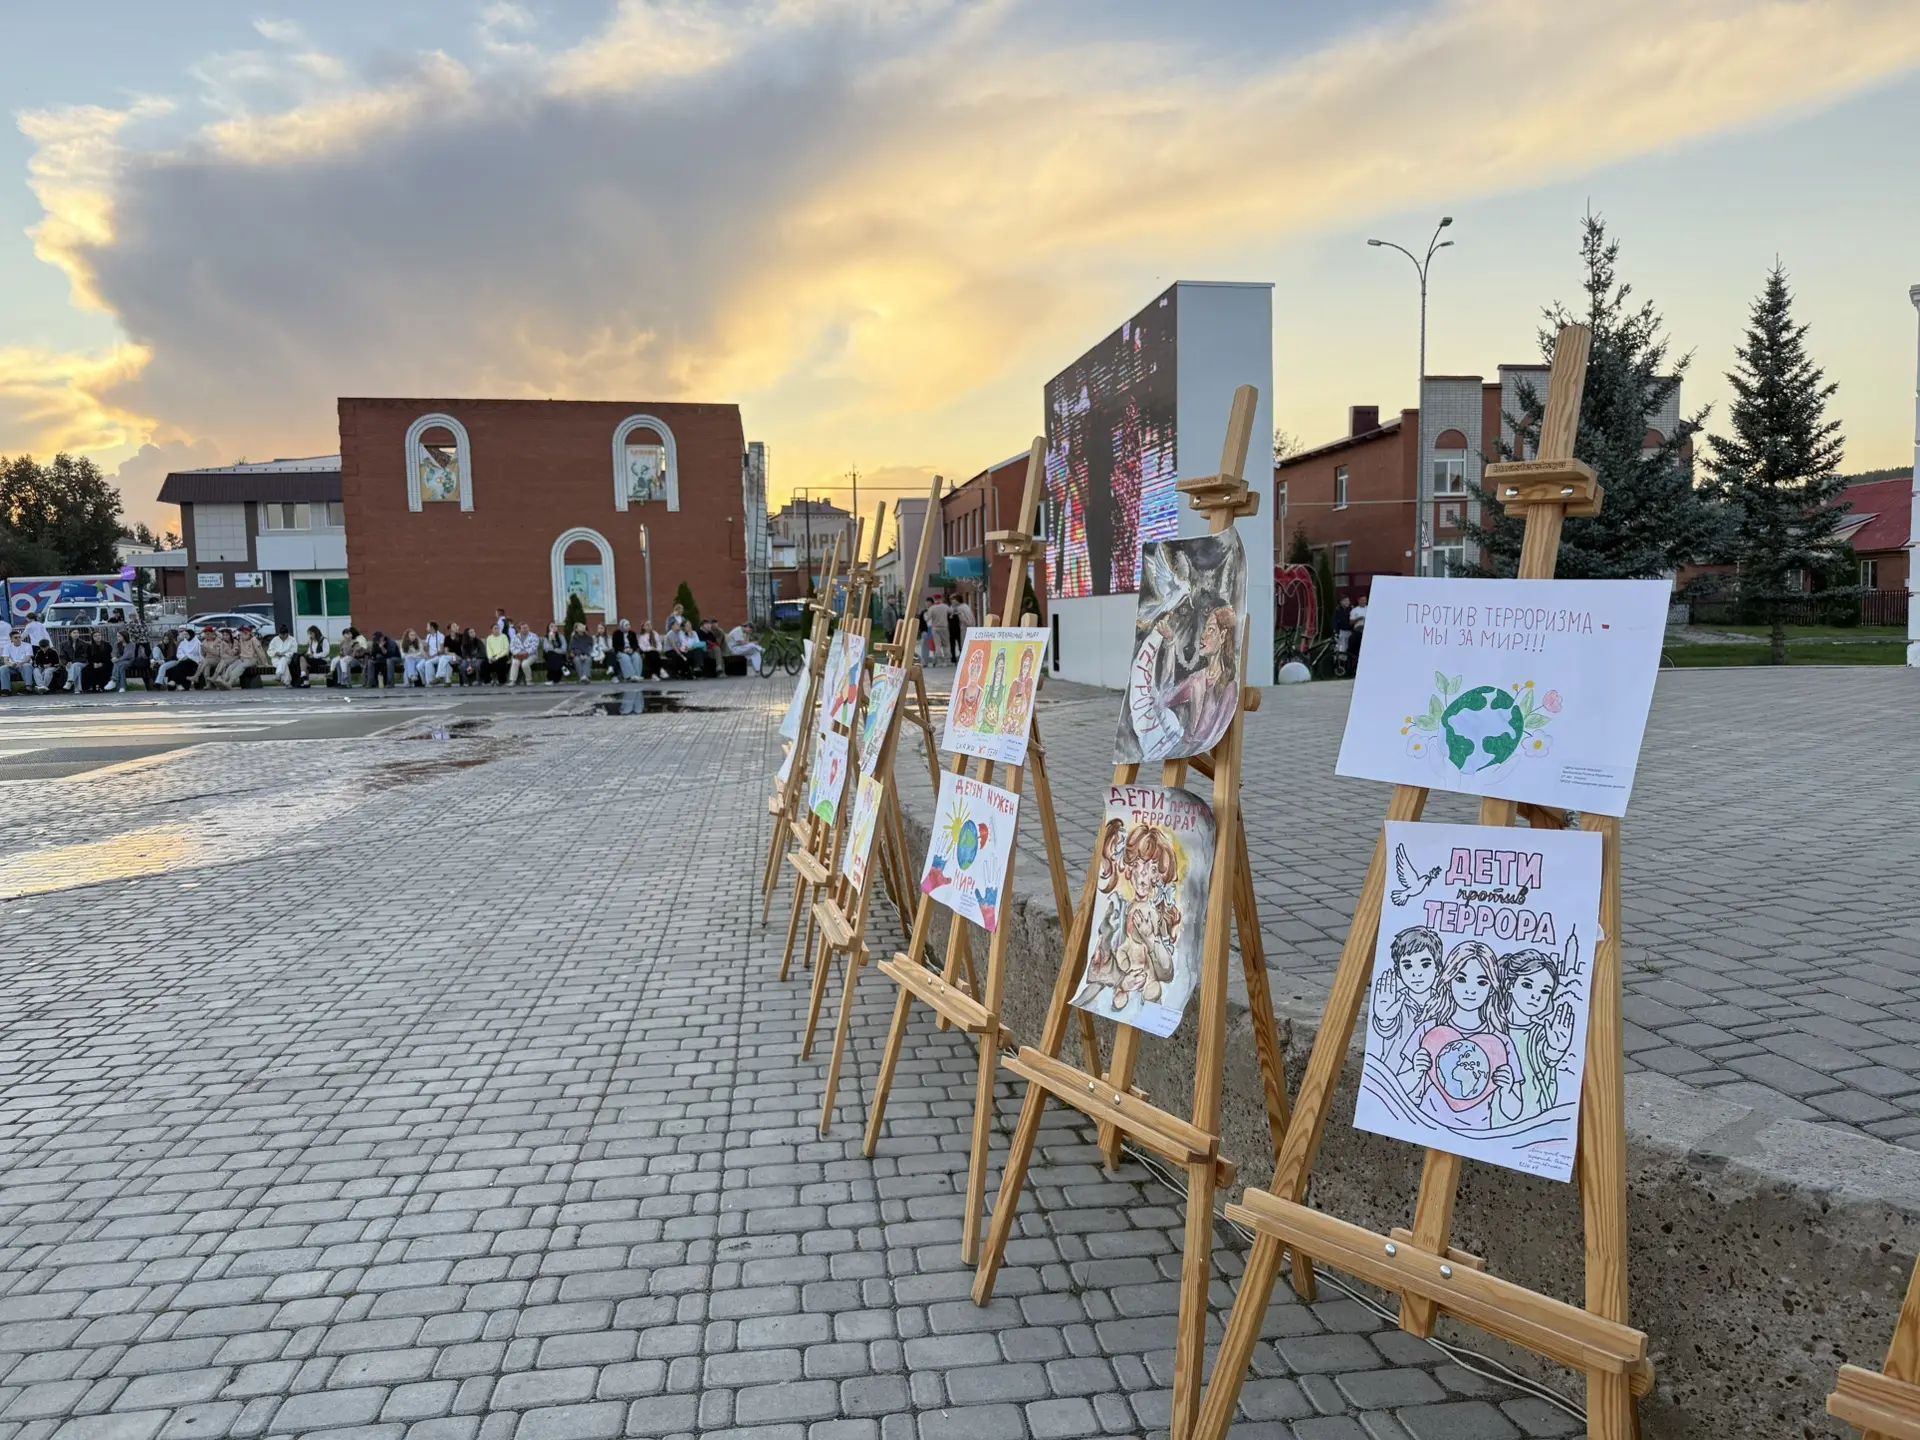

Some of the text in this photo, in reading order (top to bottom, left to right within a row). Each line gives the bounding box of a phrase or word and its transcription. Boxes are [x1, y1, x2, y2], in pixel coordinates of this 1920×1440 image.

[1406, 603, 1477, 627] ПРОТИВ
[1485, 606, 1593, 635] ТЕРРОРИЗМА
[1423, 626, 1546, 653] МЫ ЗА МИР!!!
[955, 779, 1015, 816] ДЕТЯМ НУЖЕН
[1109, 786, 1165, 810] ДЕТИ
[1132, 810, 1197, 832] ТЕРРОРА!
[952, 868, 976, 895] МИР!
[1445, 848, 1543, 889] ДЕТИ
[1456, 886, 1529, 908] против
[1424, 900, 1556, 945] ТЕРРОРА
